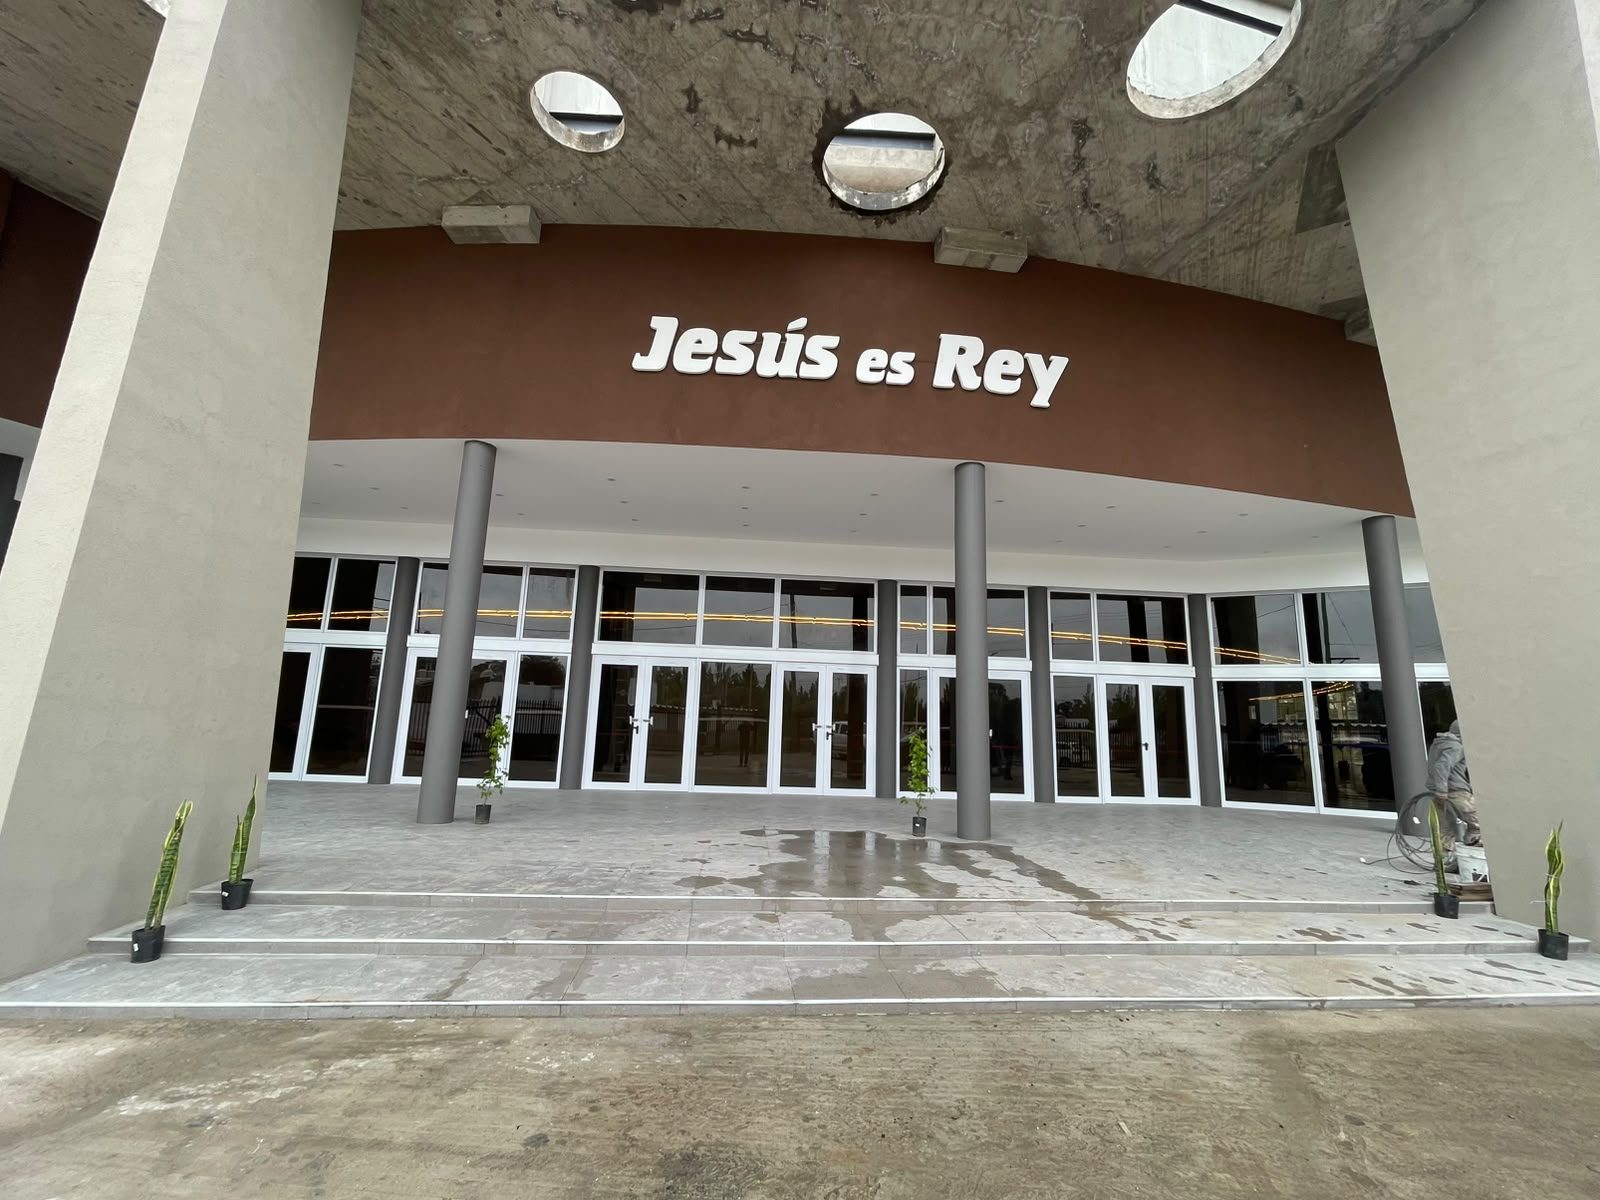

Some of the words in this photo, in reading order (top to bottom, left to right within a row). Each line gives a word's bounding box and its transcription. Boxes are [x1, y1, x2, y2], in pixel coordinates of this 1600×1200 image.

[631, 315, 841, 379] Jesús
[855, 348, 916, 386] es
[932, 333, 1069, 408] Rey
